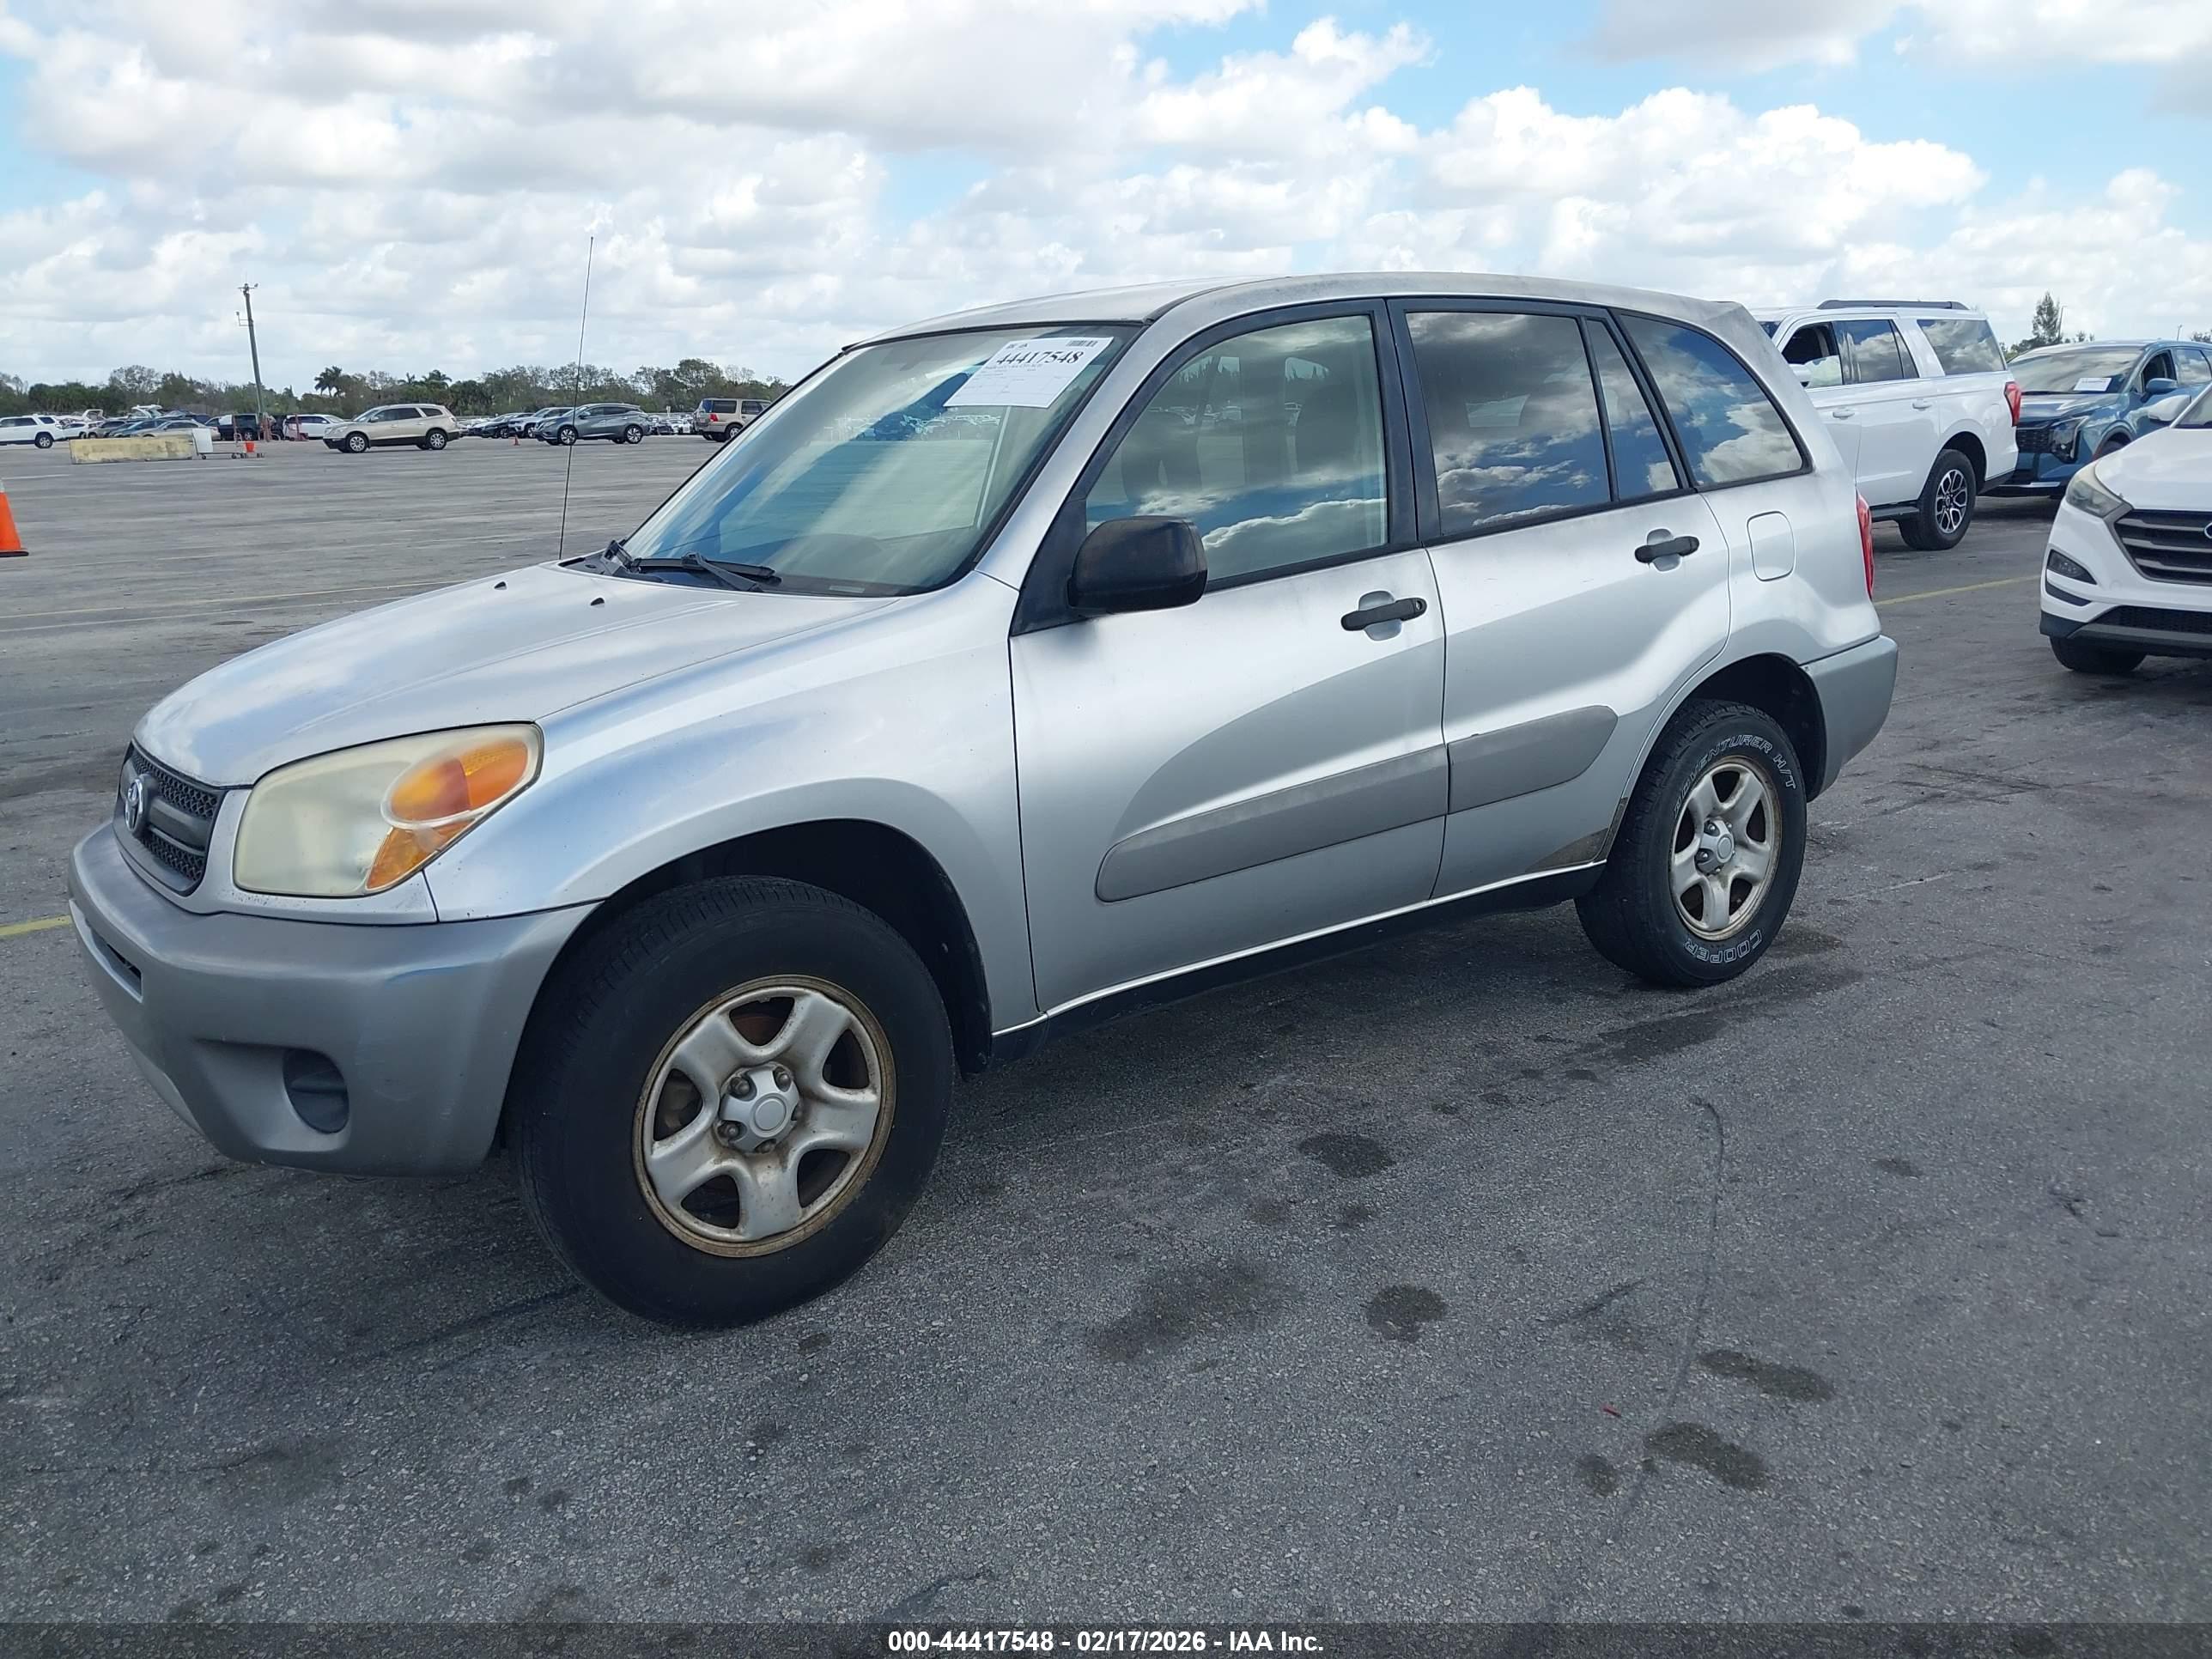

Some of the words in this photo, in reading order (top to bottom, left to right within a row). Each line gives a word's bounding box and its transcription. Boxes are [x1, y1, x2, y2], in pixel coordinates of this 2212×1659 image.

[996, 350, 1085, 365] 44417548
[1674, 734, 1773, 819] ADVENTURER
[1773, 754, 1796, 789] H/T
[1685, 929, 1762, 963] COOPER
